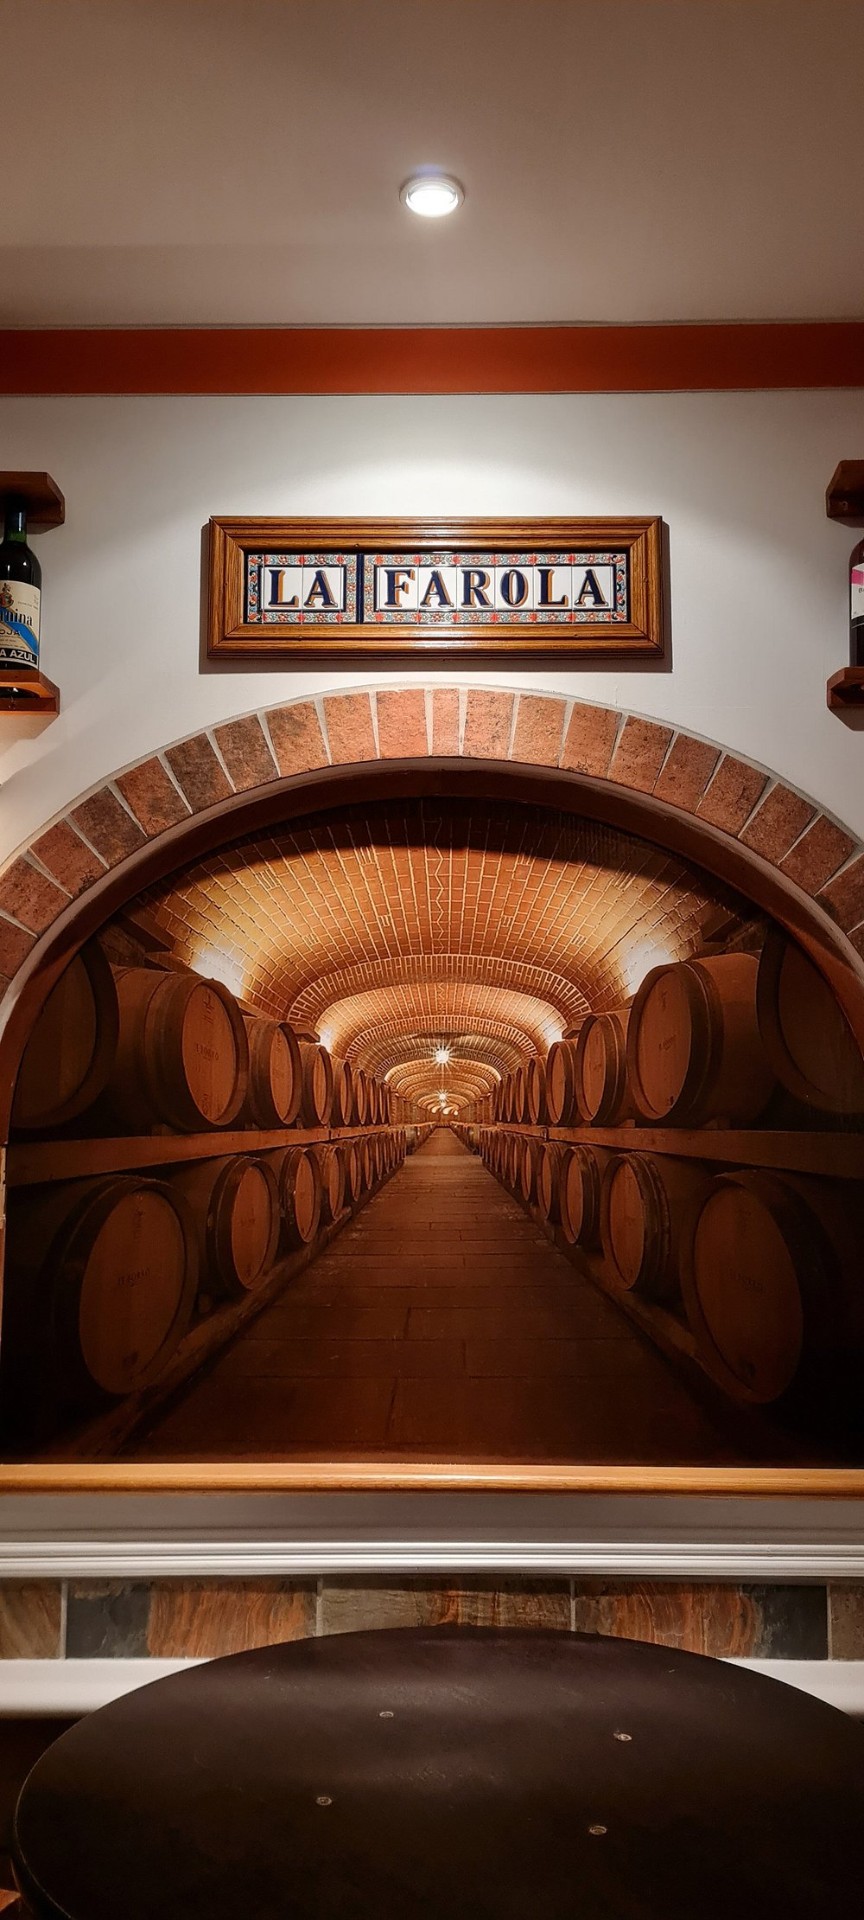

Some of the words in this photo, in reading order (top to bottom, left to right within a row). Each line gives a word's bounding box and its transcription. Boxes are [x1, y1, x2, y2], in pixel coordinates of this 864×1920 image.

[267, 568, 337, 608] LA
[384, 568, 610, 609] FAROLA
[9, 649, 35, 662] AZUL
